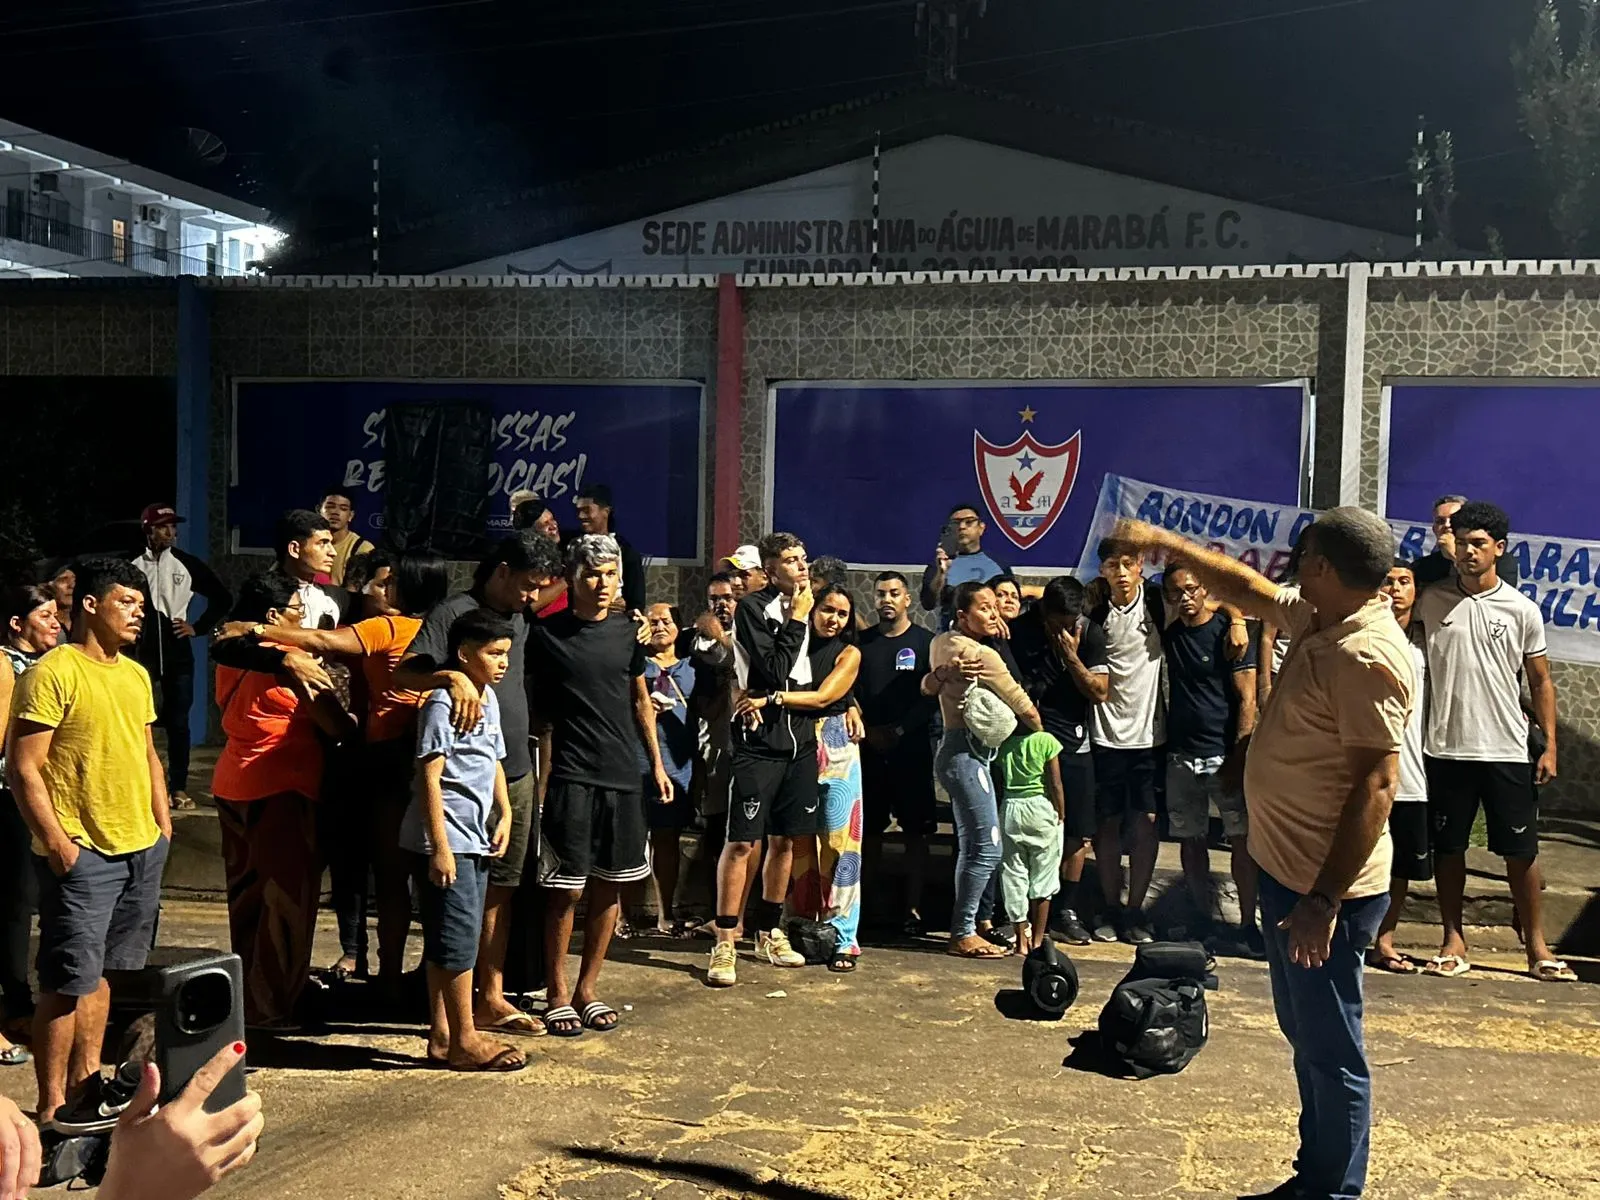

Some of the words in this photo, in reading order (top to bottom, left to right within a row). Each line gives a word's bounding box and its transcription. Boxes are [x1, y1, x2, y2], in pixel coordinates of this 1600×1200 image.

[642, 221, 706, 255] SEDE
[712, 220, 917, 255] ADMINISTRATIVA
[917, 226, 937, 245] DO
[936, 209, 1016, 253] ÁGUIA
[1017, 225, 1035, 243] DE
[1036, 205, 1171, 251] MARABÁ
[1136, 490, 1280, 545] RONDON
